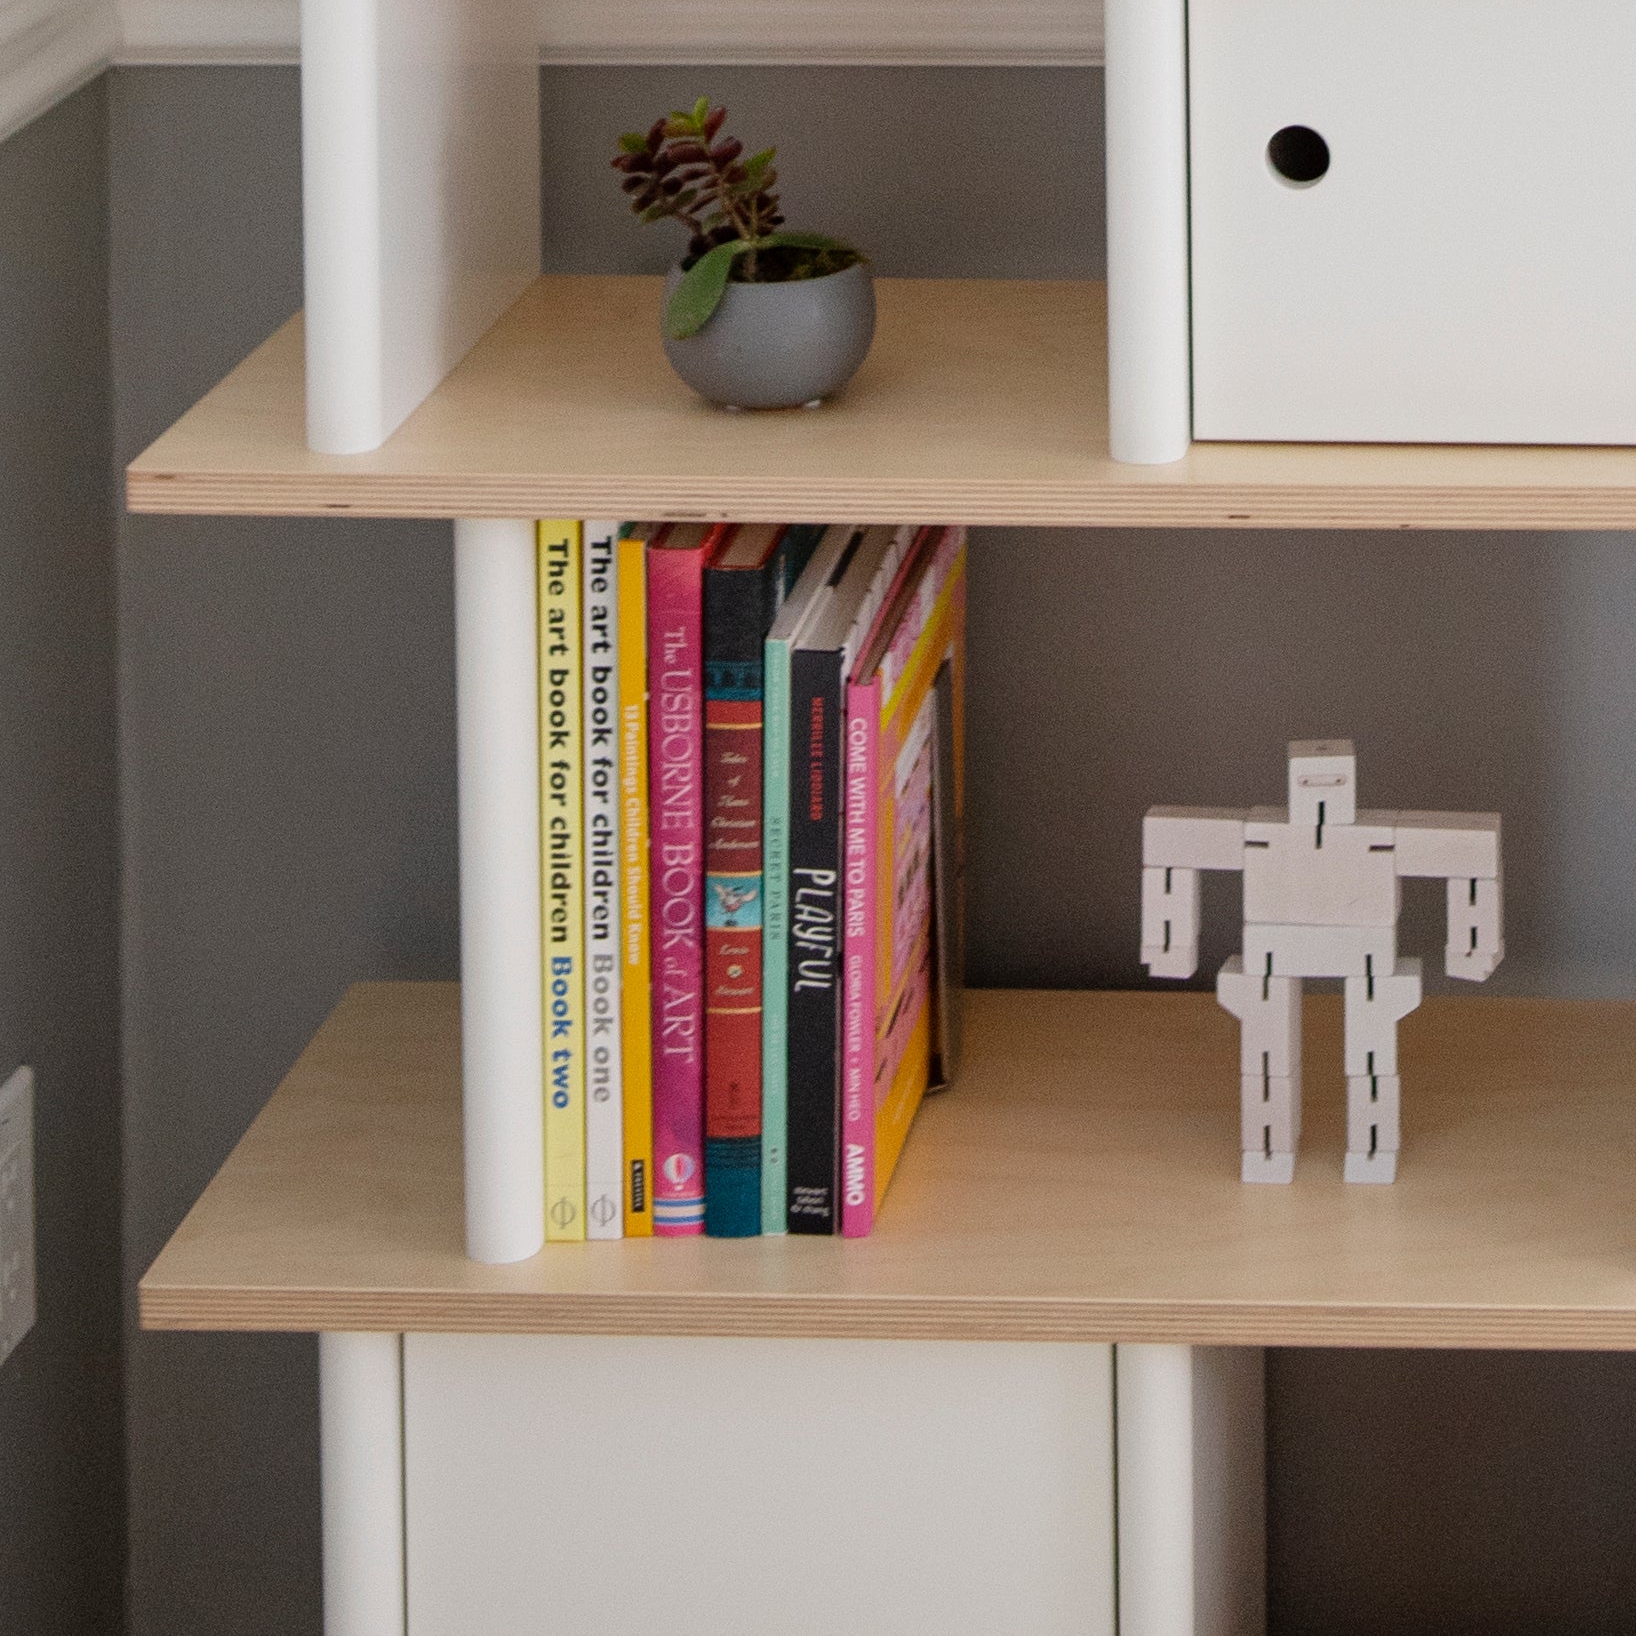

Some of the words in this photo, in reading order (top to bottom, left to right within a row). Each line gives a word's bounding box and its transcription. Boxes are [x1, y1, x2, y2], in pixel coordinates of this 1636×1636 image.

[547, 538, 569, 596] The
[591, 535, 613, 594] The
[549, 608, 569, 656] art
[591, 605, 612, 654] art
[663, 627, 687, 664] The
[549, 669, 570, 749] book
[591, 666, 613, 747] book
[622, 721, 641, 794] Paintings
[660, 670, 693, 829] USBORNE
[849, 717, 868, 774] COME
[550, 759, 571, 807] for
[592, 757, 613, 804] for
[848, 777, 867, 823] WITH
[625, 797, 642, 863] Children
[769, 816, 782, 881] SECRET
[848, 828, 866, 855] ME
[550, 816, 571, 943] children
[592, 813, 613, 940] children
[626, 866, 643, 919] Should
[662, 843, 695, 950] BOOK
[848, 861, 866, 884] TO
[769, 890, 781, 940] PARIS
[792, 868, 837, 992] PLAYFUL
[848, 888, 866, 937] PARIS
[627, 923, 643, 965] Know
[663, 956, 688, 978] of
[552, 956, 573, 1038] Book
[593, 954, 613, 1036] Book
[662, 985, 695, 1063] ART
[552, 1048, 572, 1109] two
[593, 1046, 610, 1104] one
[847, 1143, 865, 1206] AMMO
